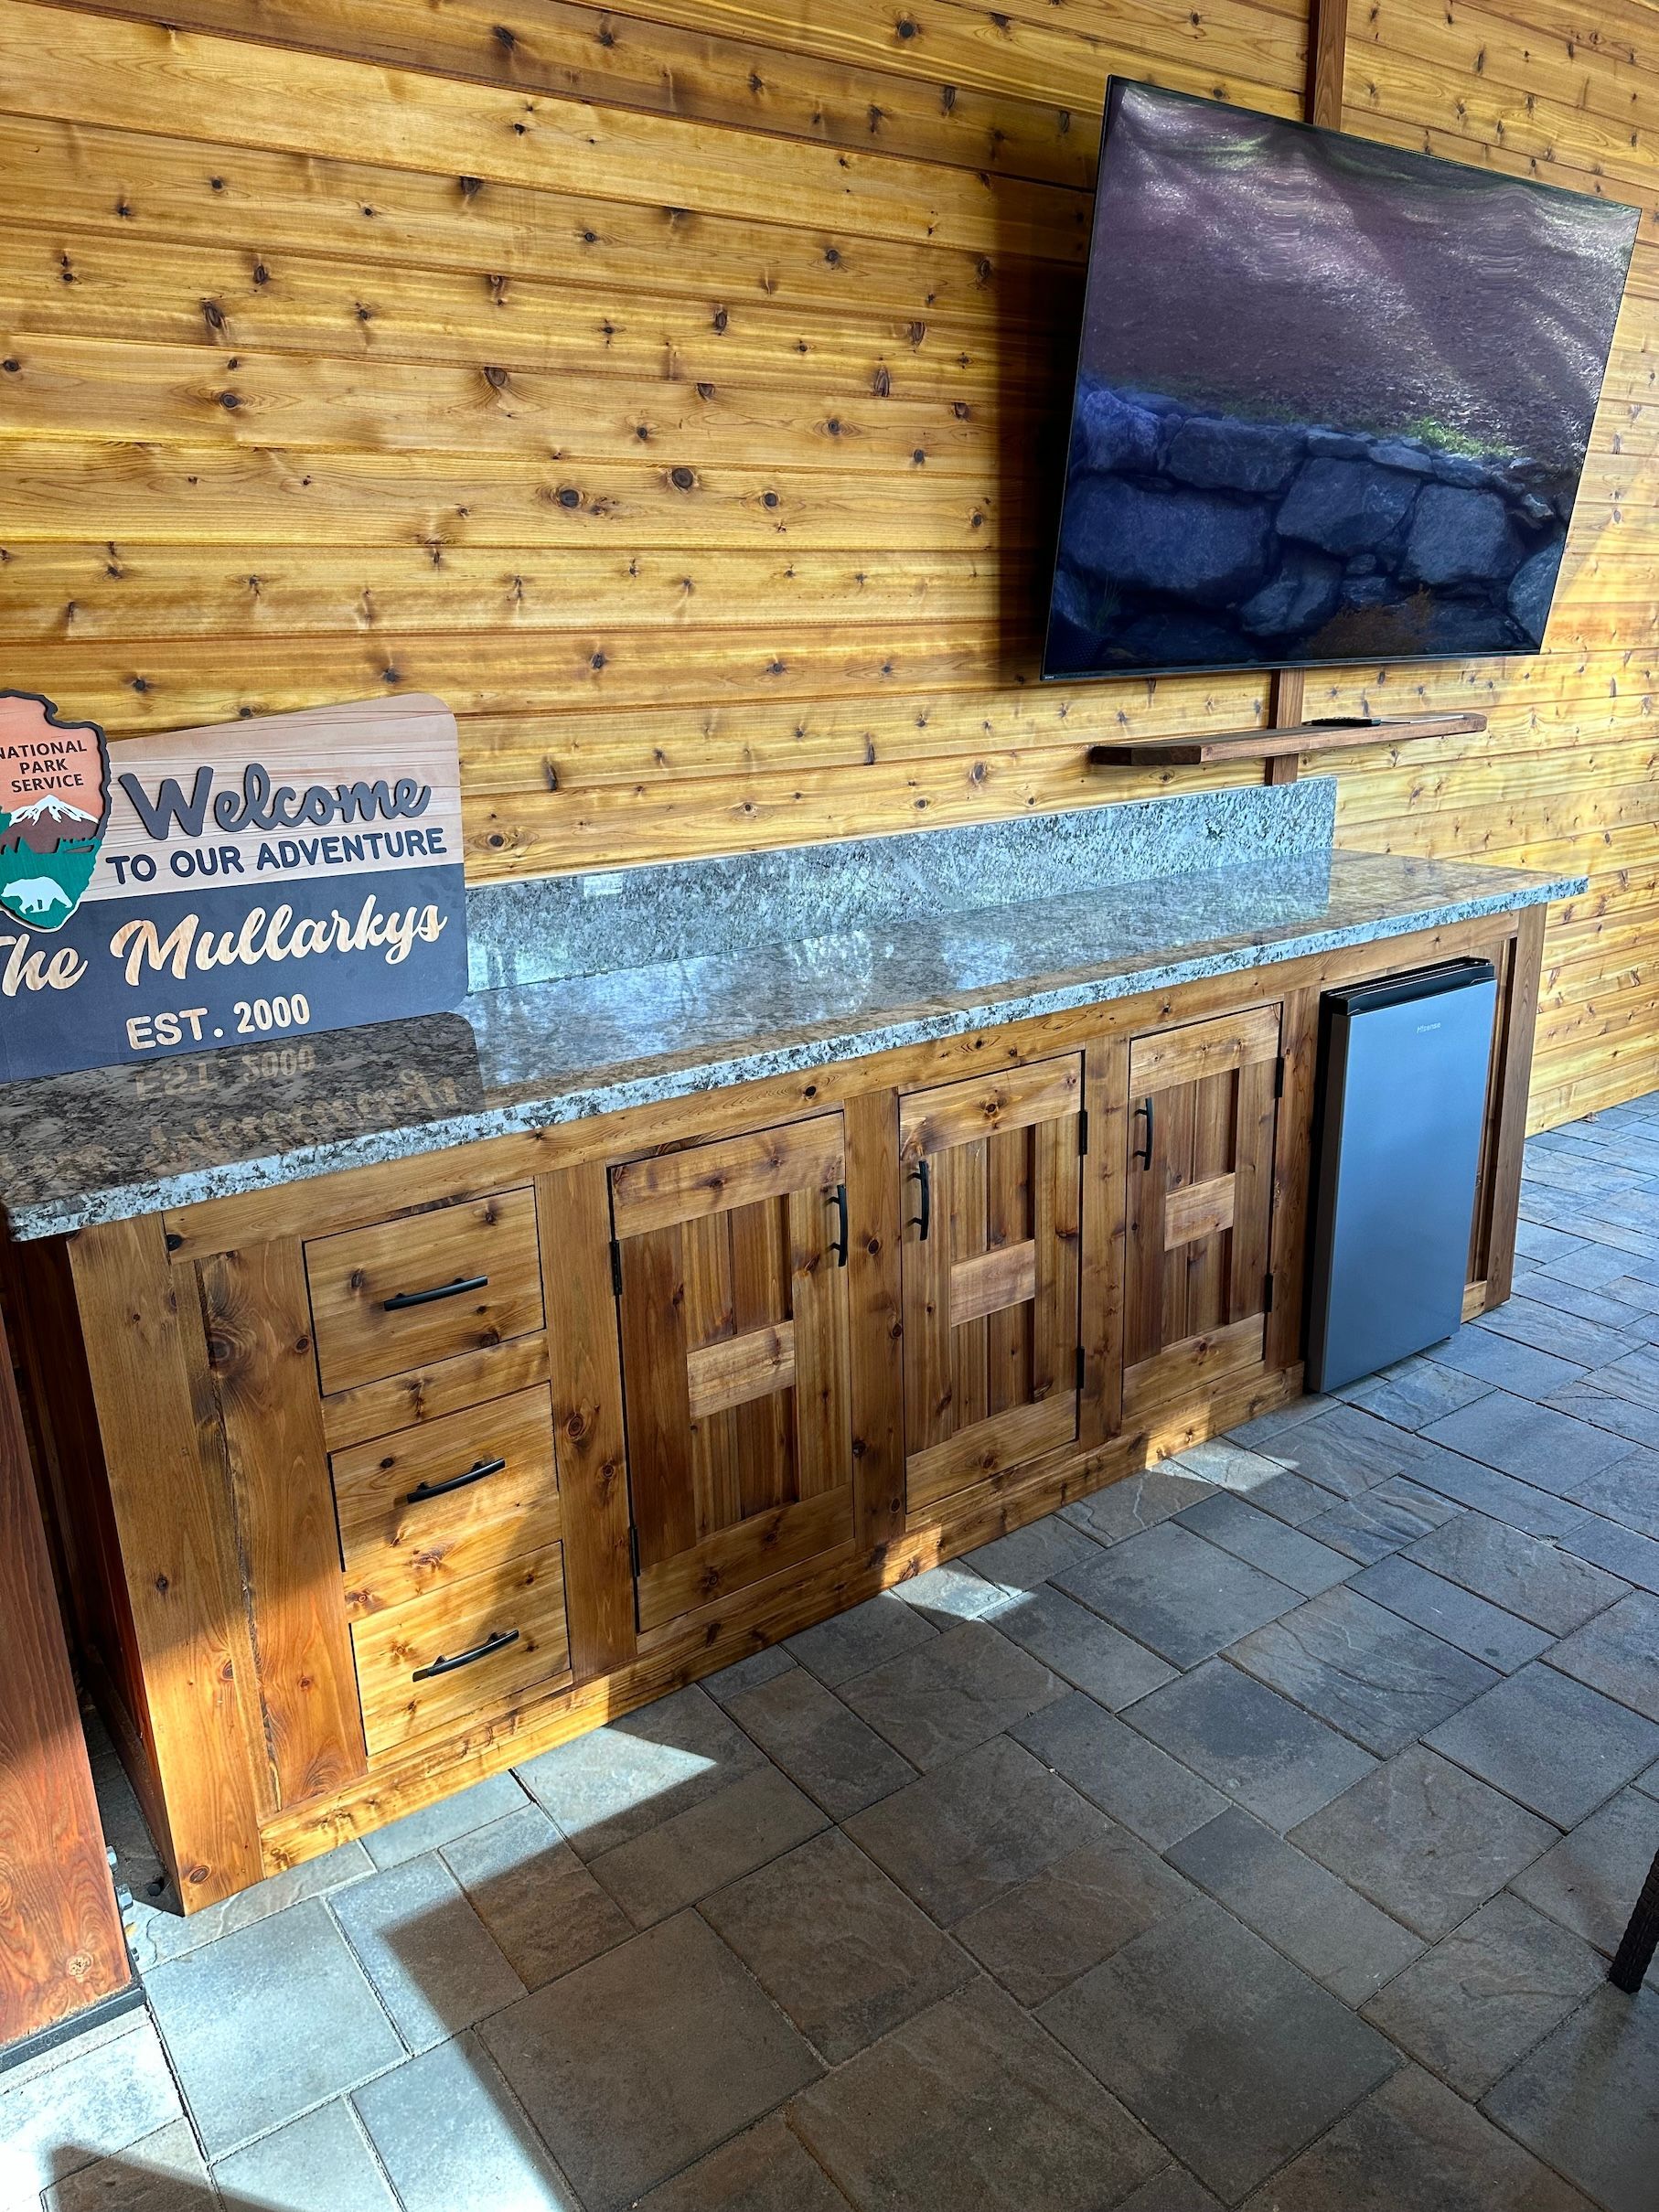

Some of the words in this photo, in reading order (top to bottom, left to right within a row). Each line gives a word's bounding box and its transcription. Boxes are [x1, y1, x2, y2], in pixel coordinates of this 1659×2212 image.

[11, 774, 84, 793] SERVICE
[19, 758, 69, 775] PARK
[118, 763, 432, 841] Welcome
[106, 854, 156, 885] TO
[170, 845, 245, 878] OUR
[257, 827, 447, 871] ADVENTURE
[109, 893, 448, 987] Mullarkys
[126, 1007, 224, 1051] EST.
[233, 993, 311, 1034] 2000
